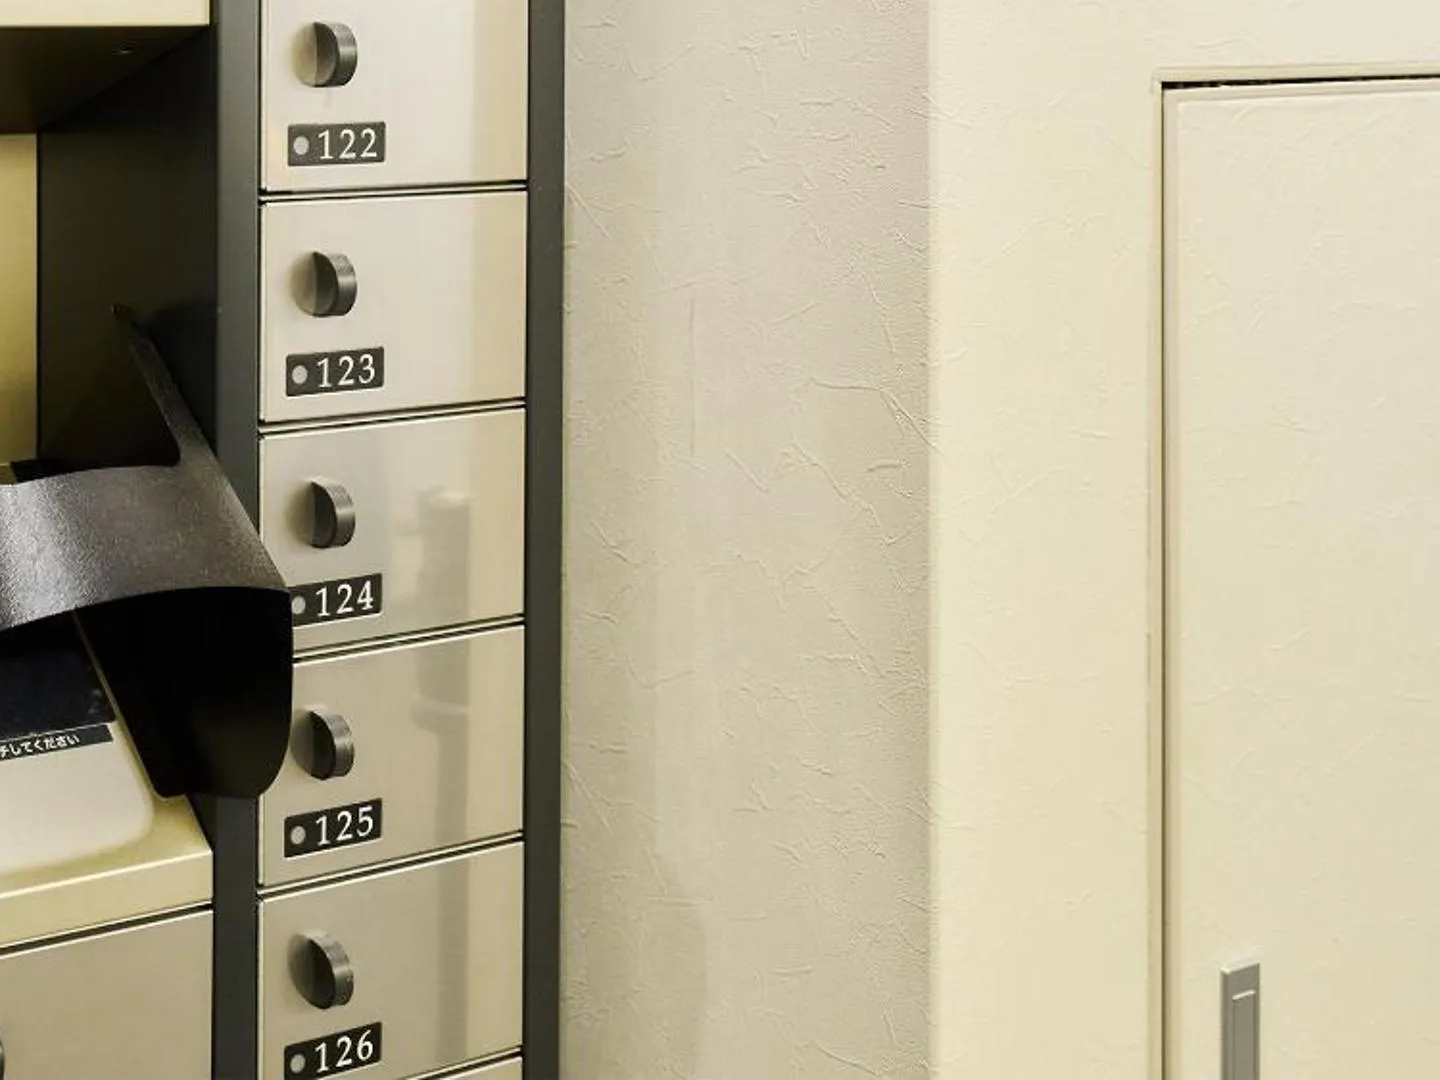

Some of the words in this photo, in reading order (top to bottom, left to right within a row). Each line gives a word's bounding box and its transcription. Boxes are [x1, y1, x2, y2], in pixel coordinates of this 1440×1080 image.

[318, 128, 377, 161] 122
[317, 353, 376, 388] 123
[316, 580, 374, 617] 124
[315, 804, 374, 847] 125
[315, 1029, 374, 1073] 126
